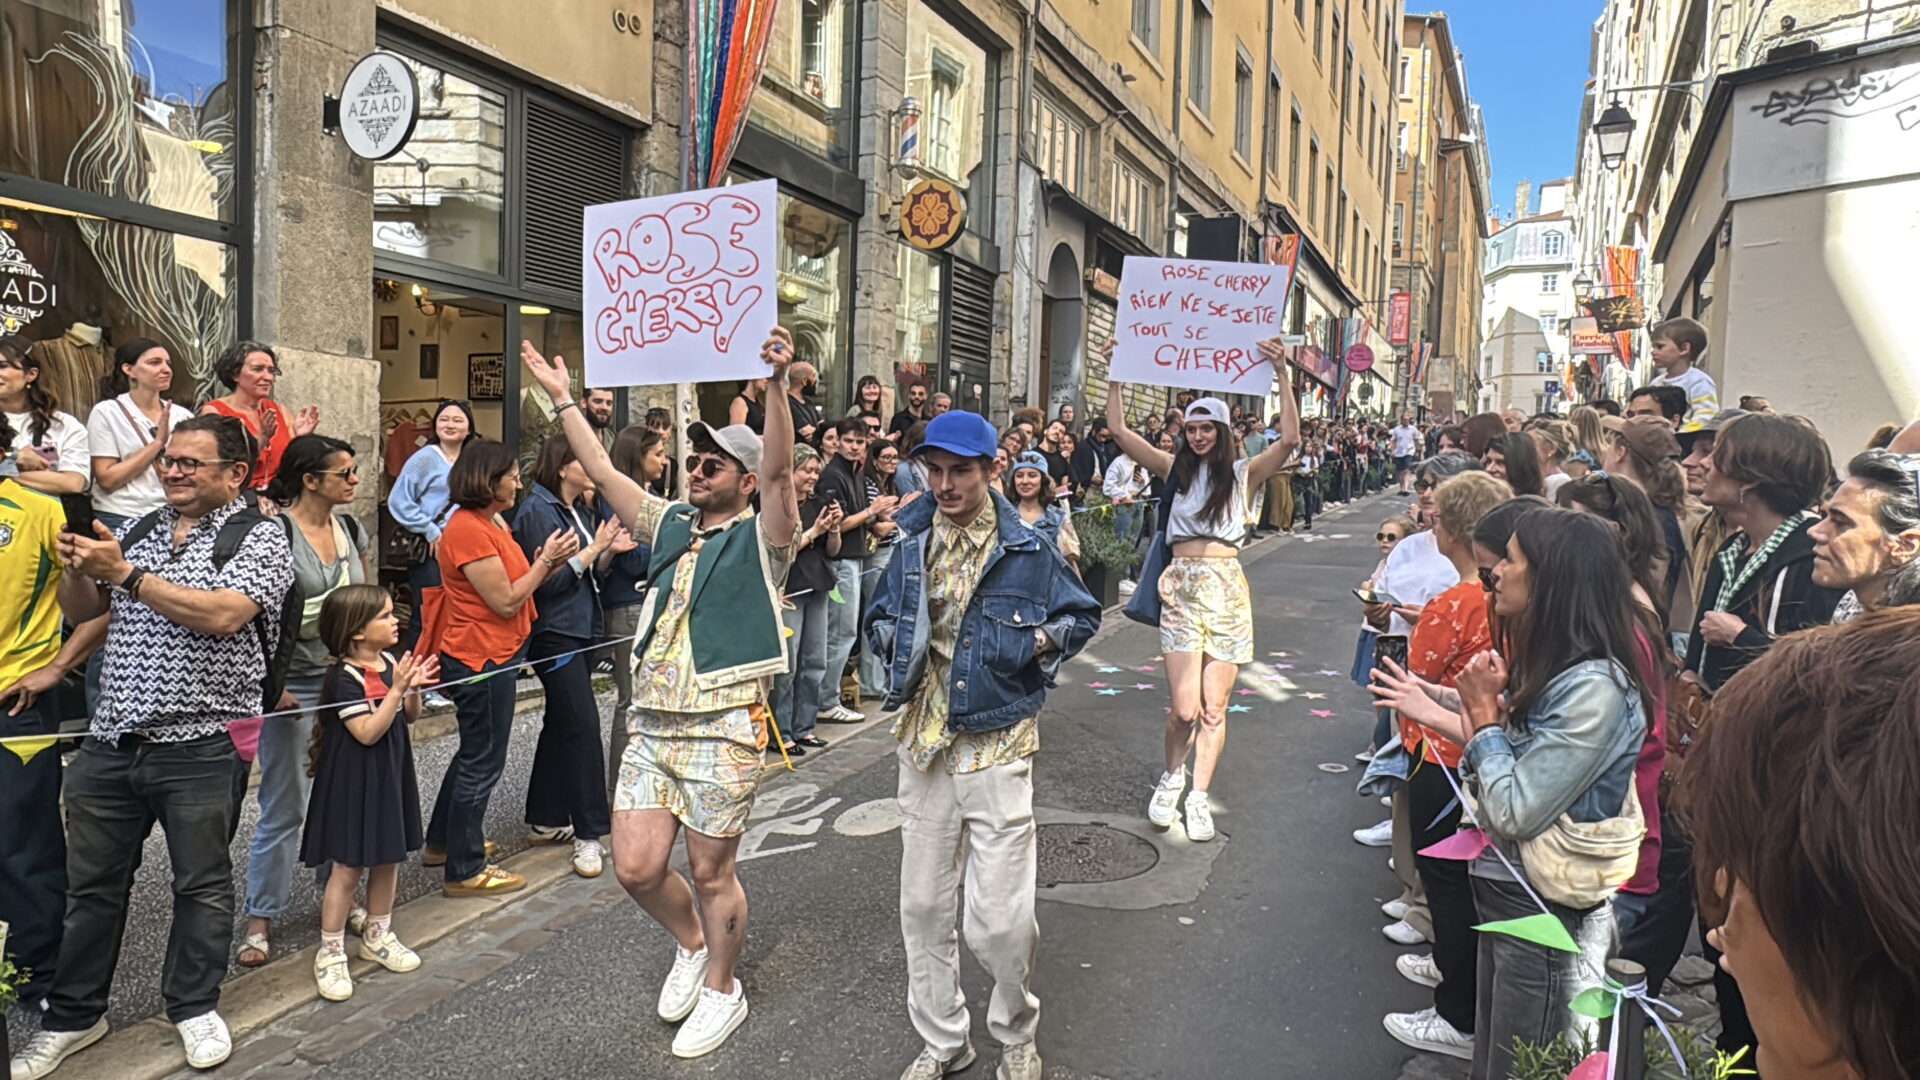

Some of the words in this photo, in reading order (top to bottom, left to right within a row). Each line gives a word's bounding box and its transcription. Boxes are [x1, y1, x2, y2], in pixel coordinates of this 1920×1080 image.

[348, 95, 407, 118] AZAADI
[594, 194, 760, 294] ROSE
[1161, 264, 1211, 281] ROSE
[1214, 274, 1271, 298] CHERRY
[595, 278, 762, 354] CHERRY
[1180, 292, 1202, 313] NE
[1208, 300, 1230, 317] SE
[1231, 305, 1277, 325] JETTE
[1128, 321, 1172, 337] TOUT
[1184, 326, 1208, 340] SE
[1154, 343, 1268, 384] CHERRY
